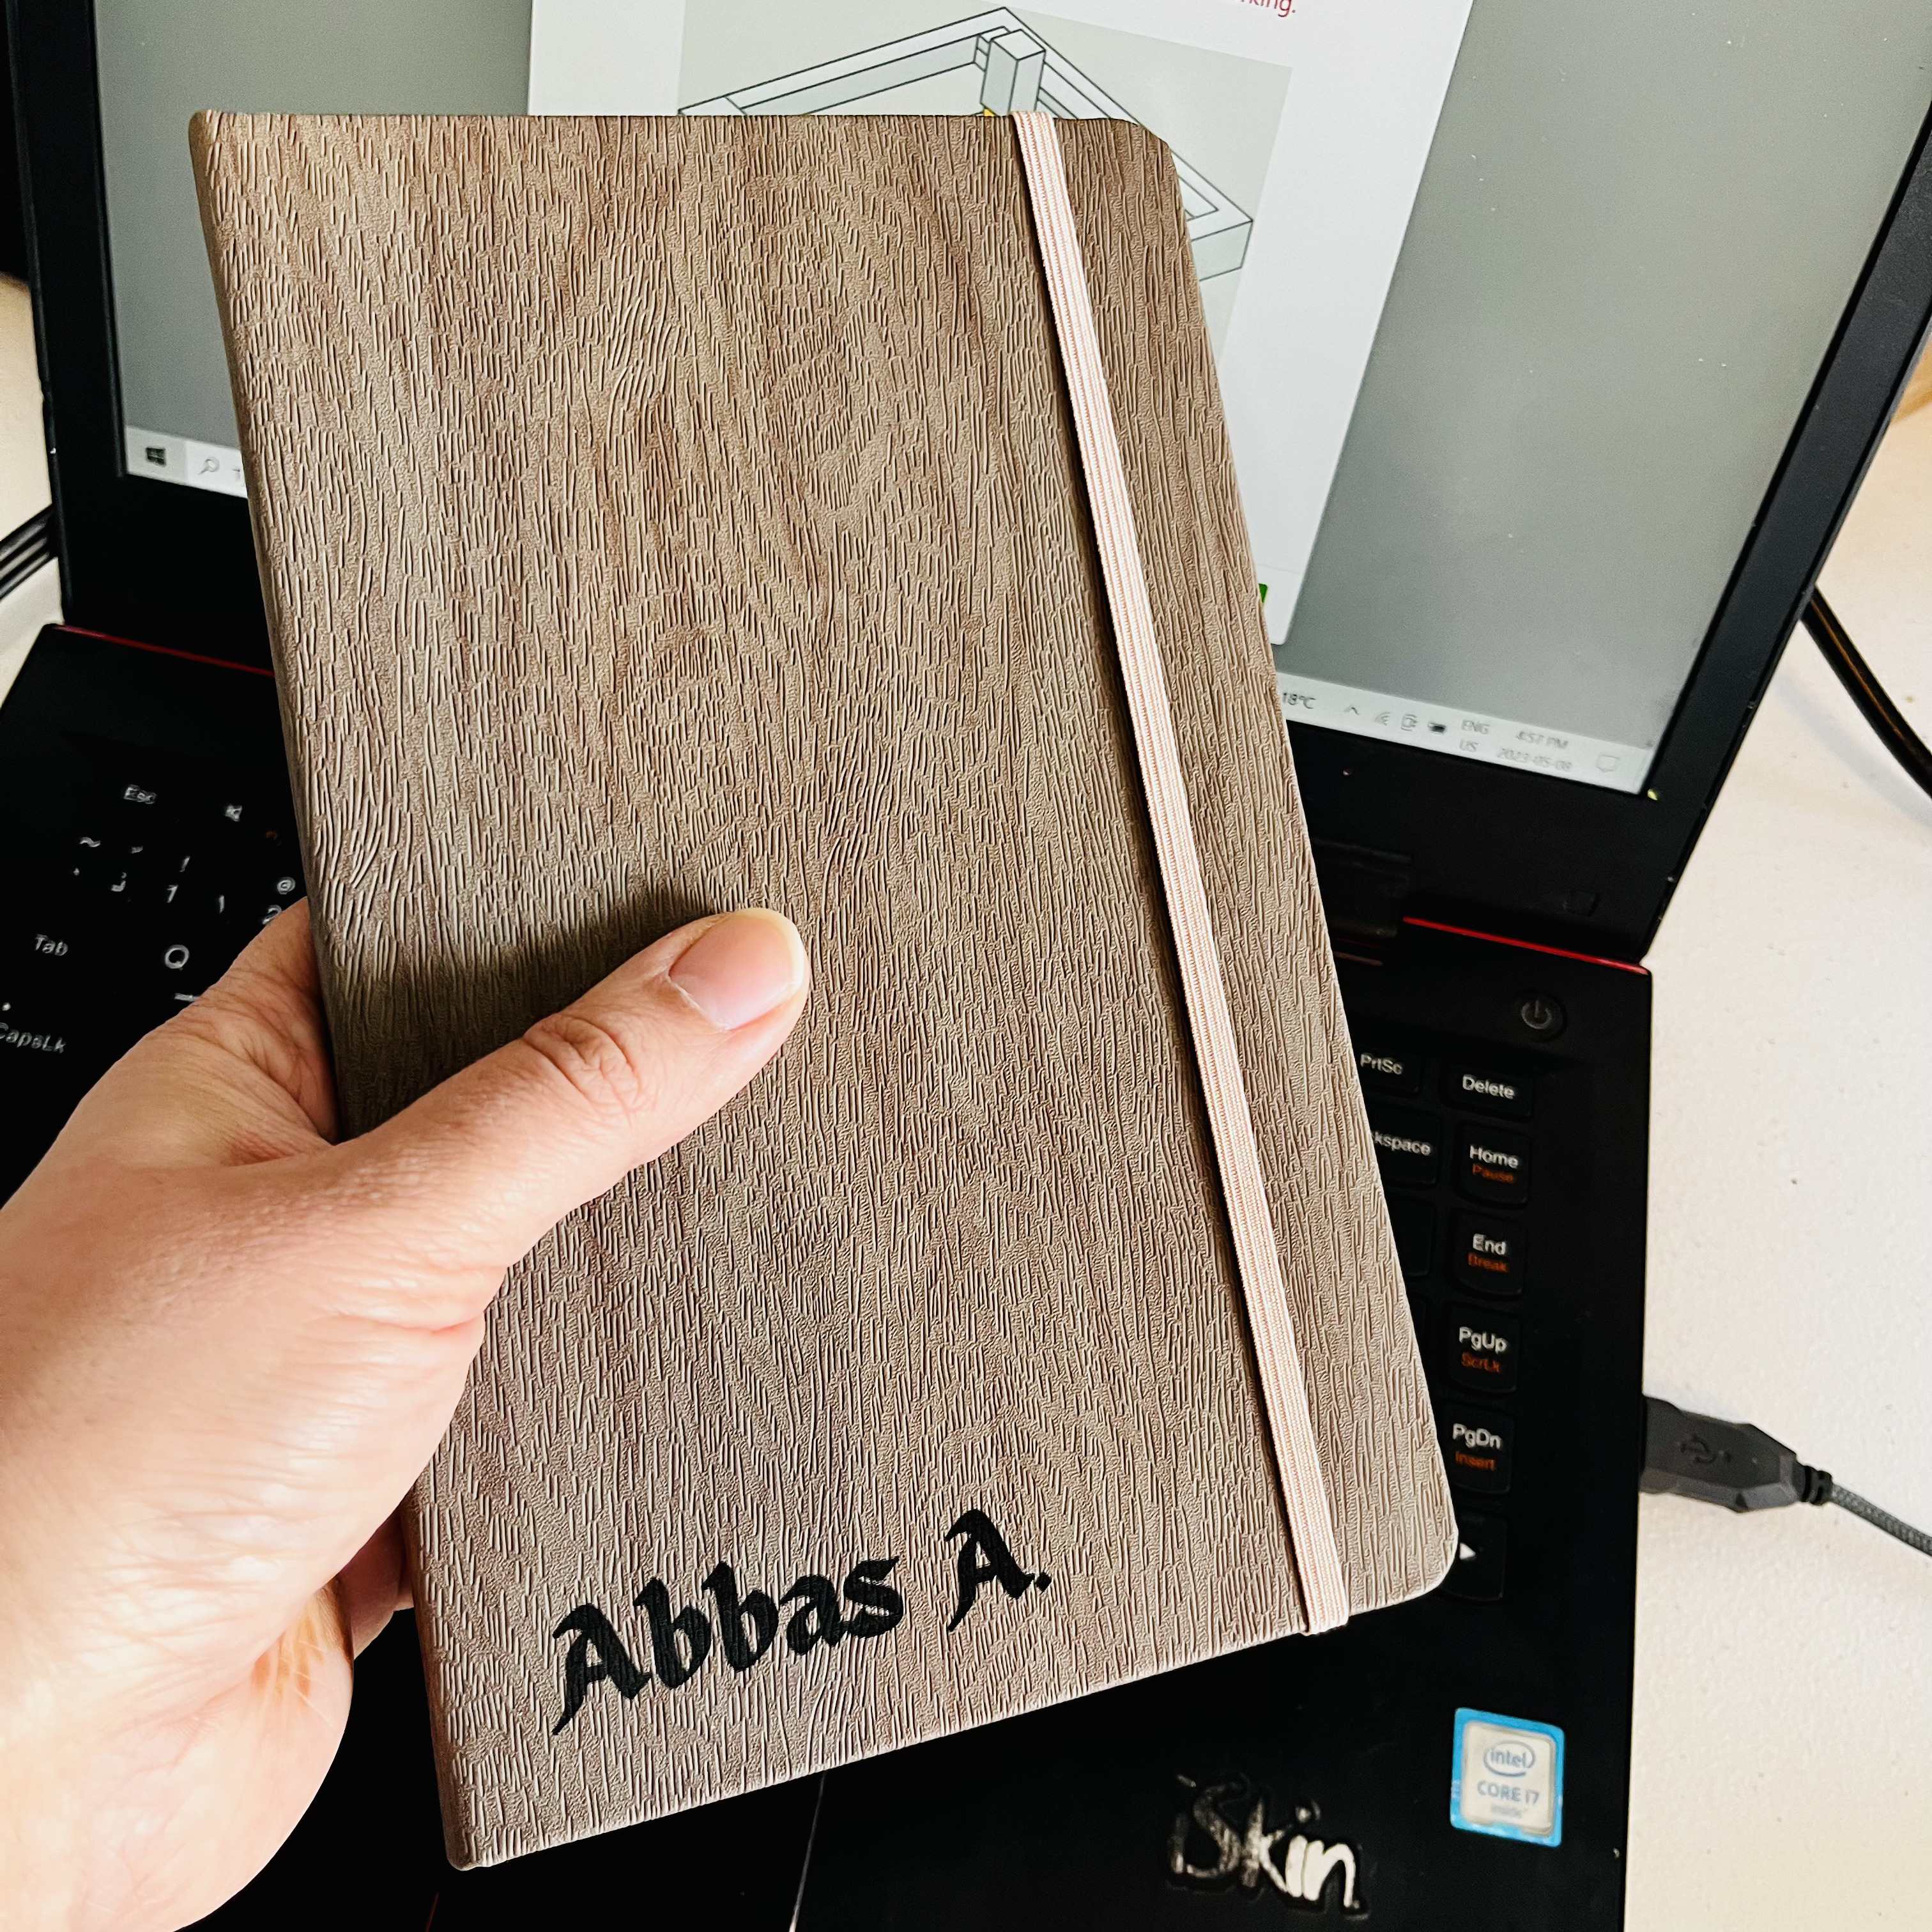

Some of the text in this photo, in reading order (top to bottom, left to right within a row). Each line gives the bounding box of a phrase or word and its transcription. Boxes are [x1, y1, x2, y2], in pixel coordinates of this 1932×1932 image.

[124, 783, 157, 805] Esc
[34, 933, 68, 956] Tab
[164, 944, 190, 971] Q
[1462, 1074, 1516, 1100] Delete
[1371, 1130, 1432, 1156] kspace
[1469, 1144, 1520, 1170] Home
[1472, 1232, 1507, 1256] End
[1459, 1326, 1508, 1355] PgUp
[1452, 1423, 1503, 1451] PgDn
[552, 1508, 1053, 1735] Abbas A.
[1489, 1748, 1527, 1768] intel
[1476, 1779, 1522, 1802] CORE
